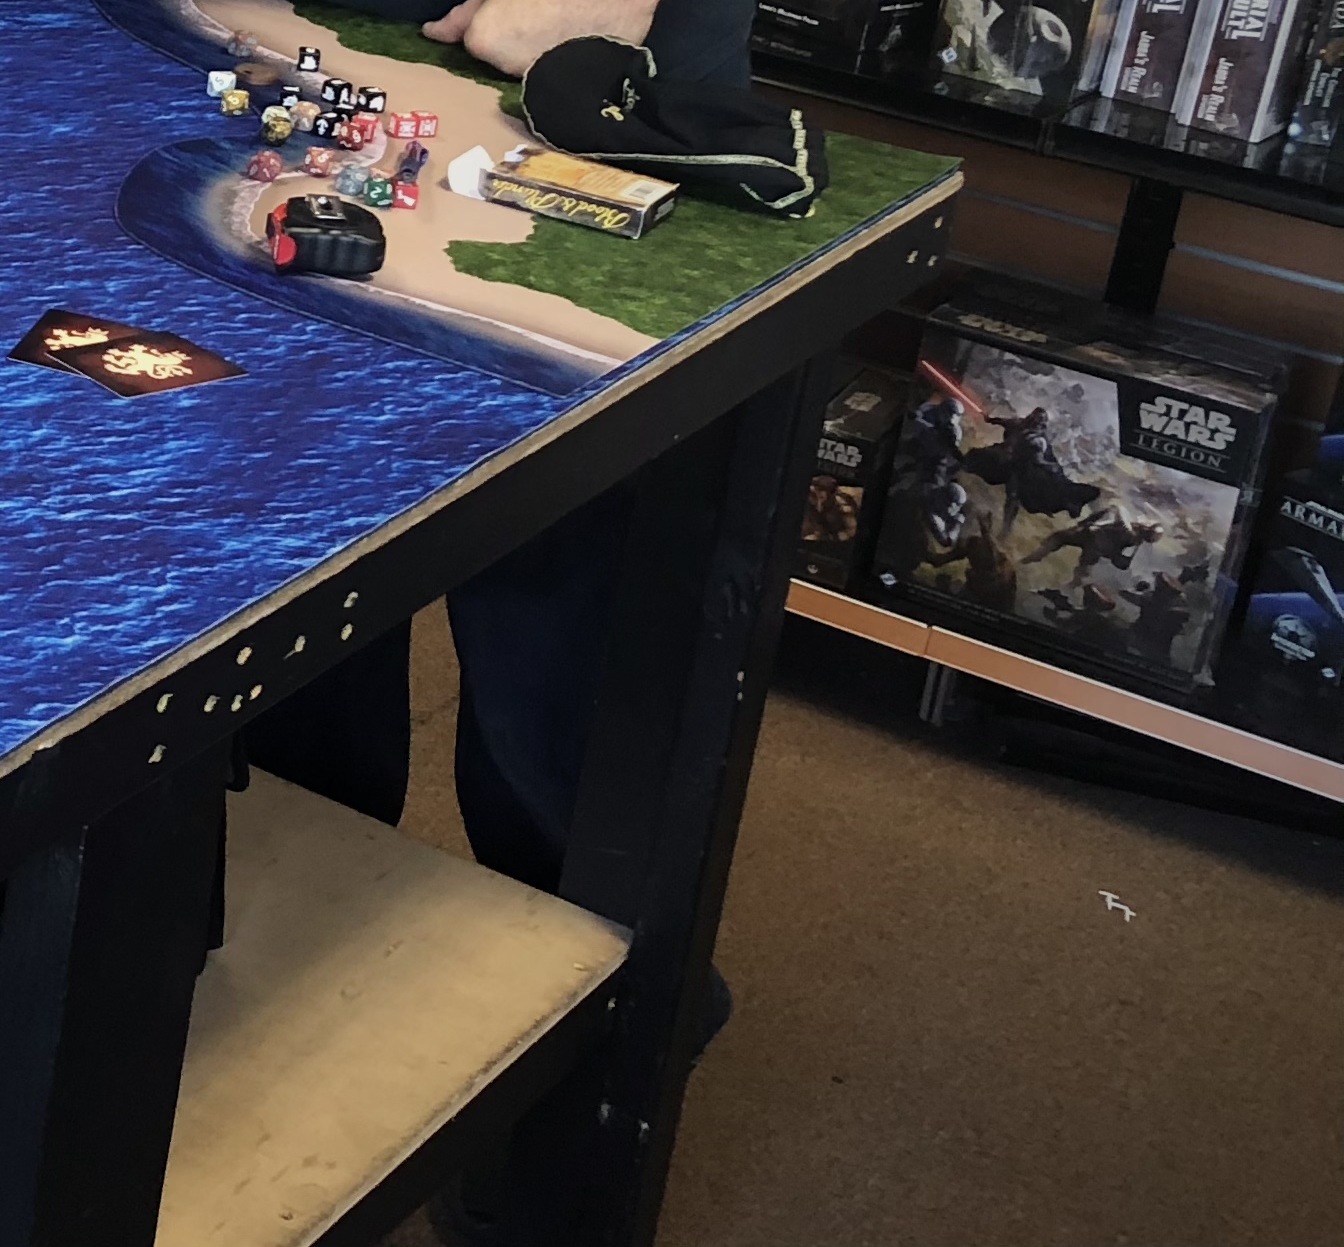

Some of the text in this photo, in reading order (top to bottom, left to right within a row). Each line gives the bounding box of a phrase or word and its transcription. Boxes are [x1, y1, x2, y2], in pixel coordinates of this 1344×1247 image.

[568, 202, 631, 229] Blood
[1139, 396, 1237, 436] STAR
[1139, 409, 1235, 452] WARS
[1136, 434, 1223, 468] LEGION
[1280, 500, 1344, 540] ARMA
